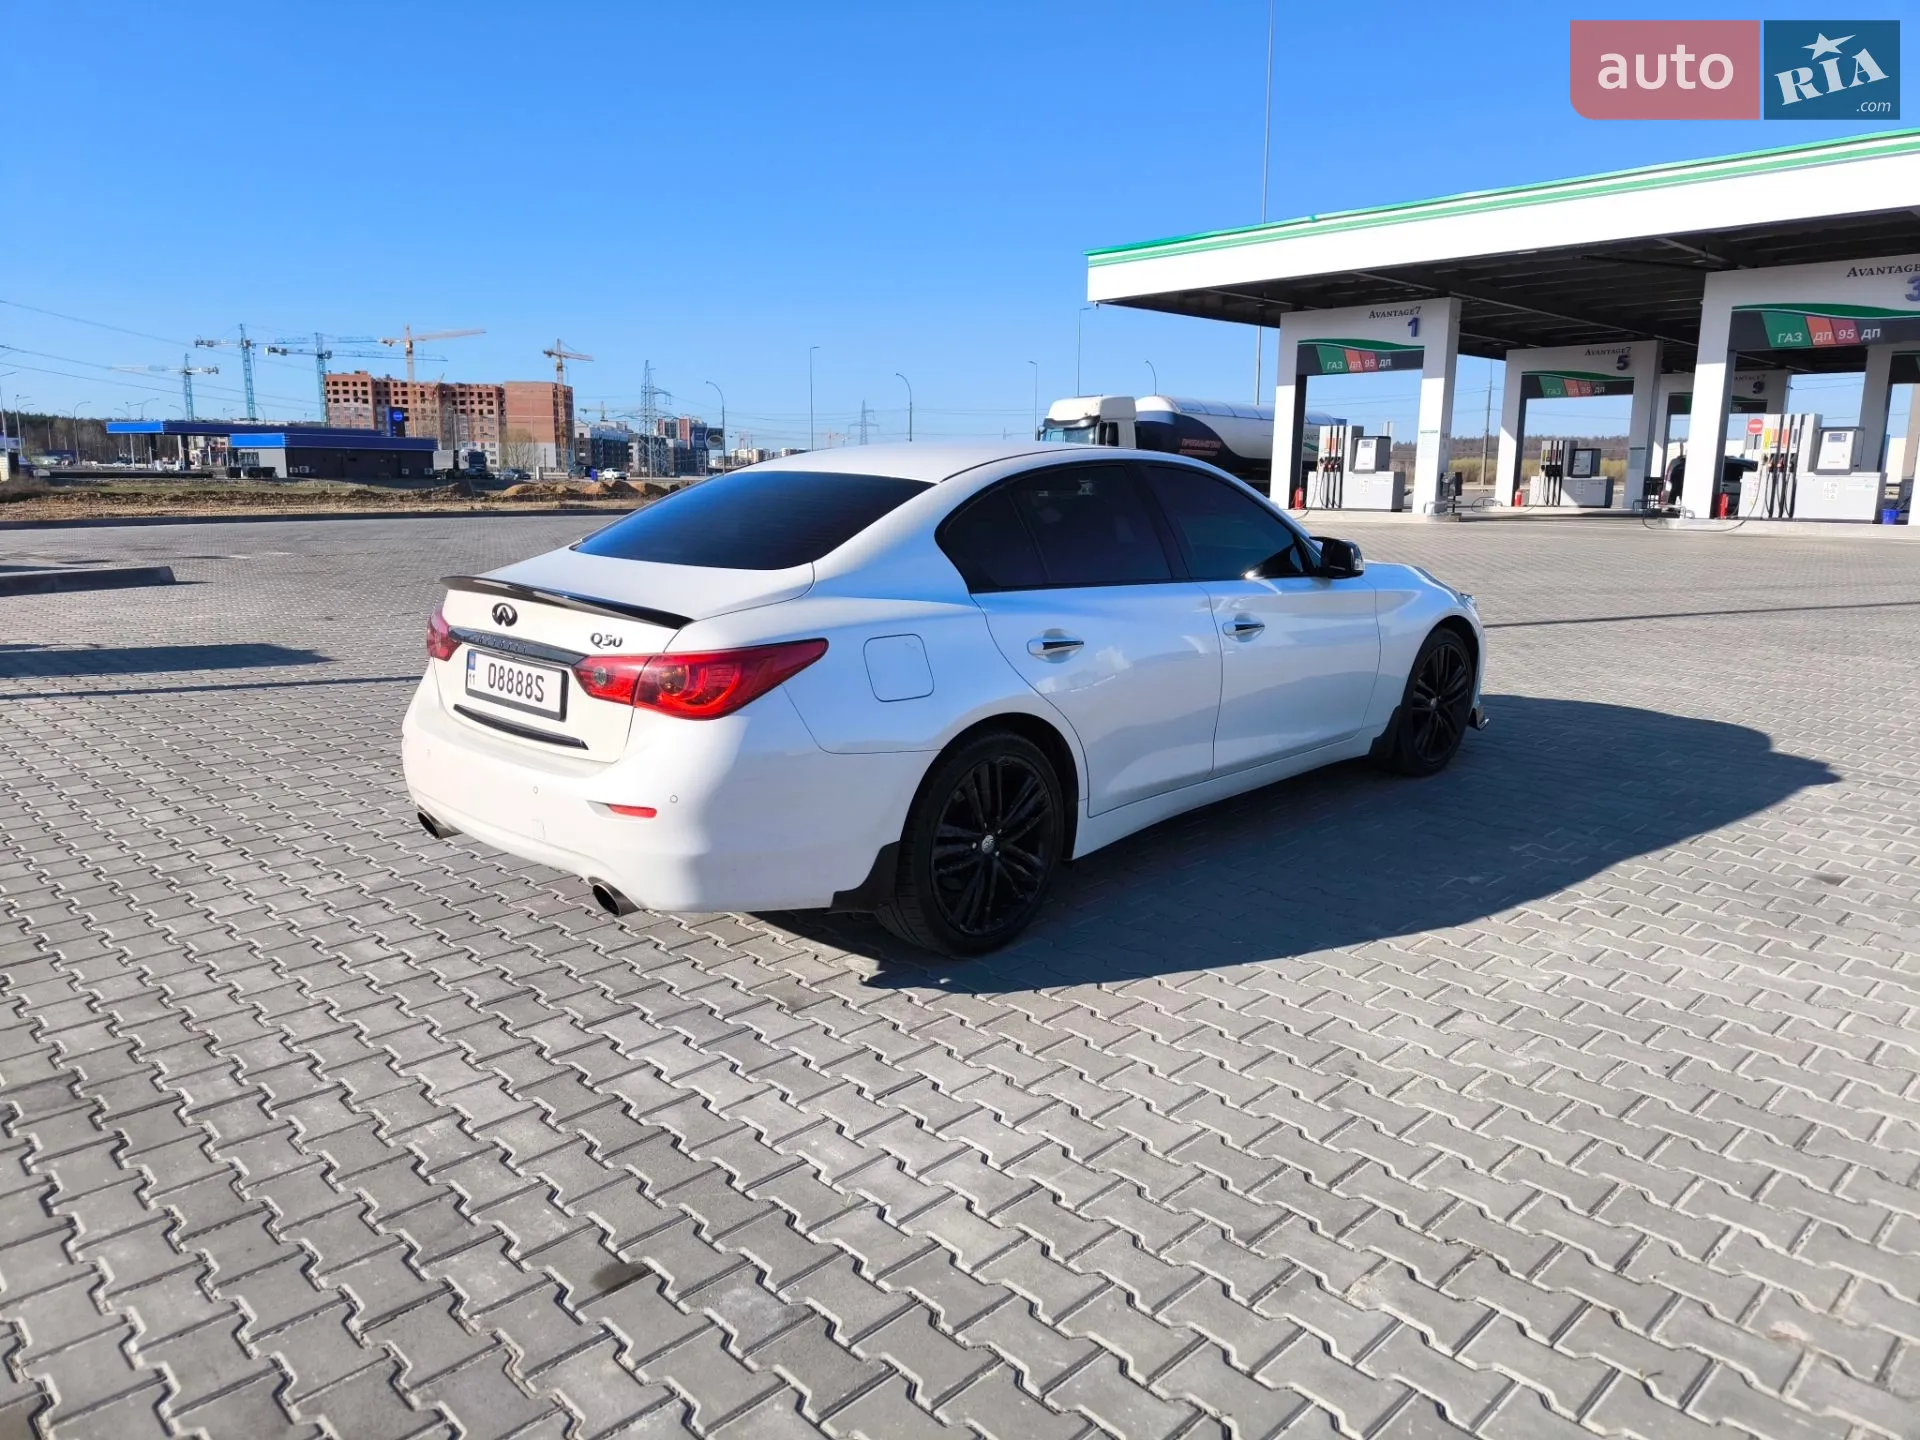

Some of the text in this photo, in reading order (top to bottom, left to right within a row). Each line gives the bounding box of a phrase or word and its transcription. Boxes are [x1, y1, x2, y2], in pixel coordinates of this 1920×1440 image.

[1904, 276, 1920, 302] 3
[1407, 317, 1420, 337] 1
[1777, 328, 1881, 344] ГАЗ ДП 95 ДП
[1326, 358, 1392, 370] ГАЗ ДП 95 ДП
[1616, 354, 1630, 371] 5
[1752, 381, 1766, 395] 9
[590, 632, 623, 649] Q50
[468, 672, 476, 685] 11
